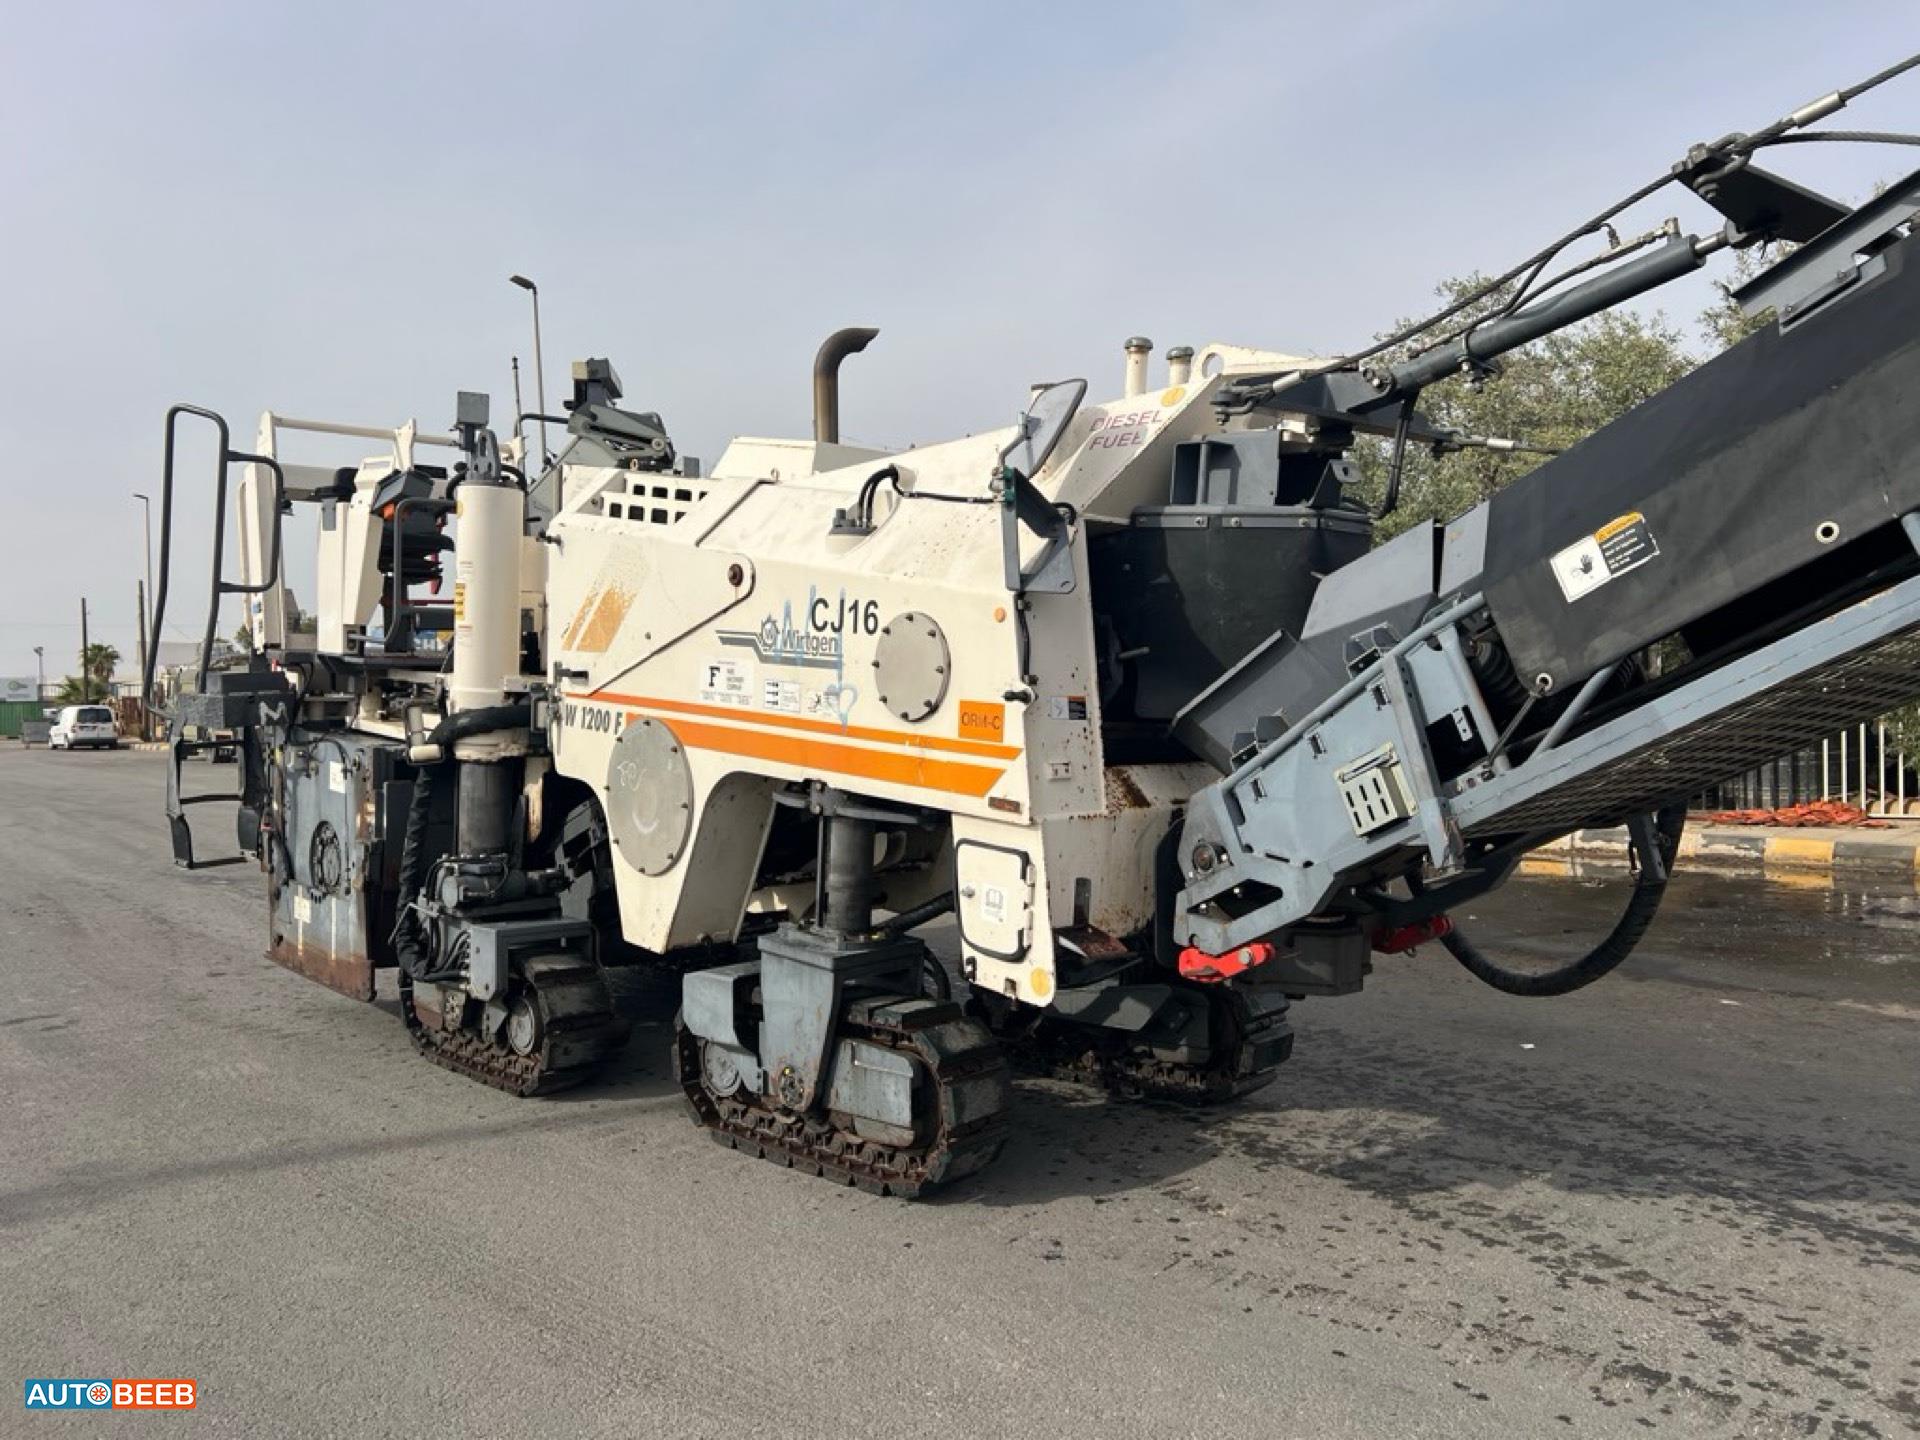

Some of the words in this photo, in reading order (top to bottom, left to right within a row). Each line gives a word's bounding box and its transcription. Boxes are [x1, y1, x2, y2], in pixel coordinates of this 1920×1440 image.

[1089, 410, 1163, 432] DIESEL
[1089, 431, 1143, 450] FUEL
[811, 598, 879, 635] CJ16
[782, 629, 840, 656] Wirtgen
[708, 665, 721, 687] F
[565, 703, 578, 727] W
[581, 706, 610, 733] 1200
